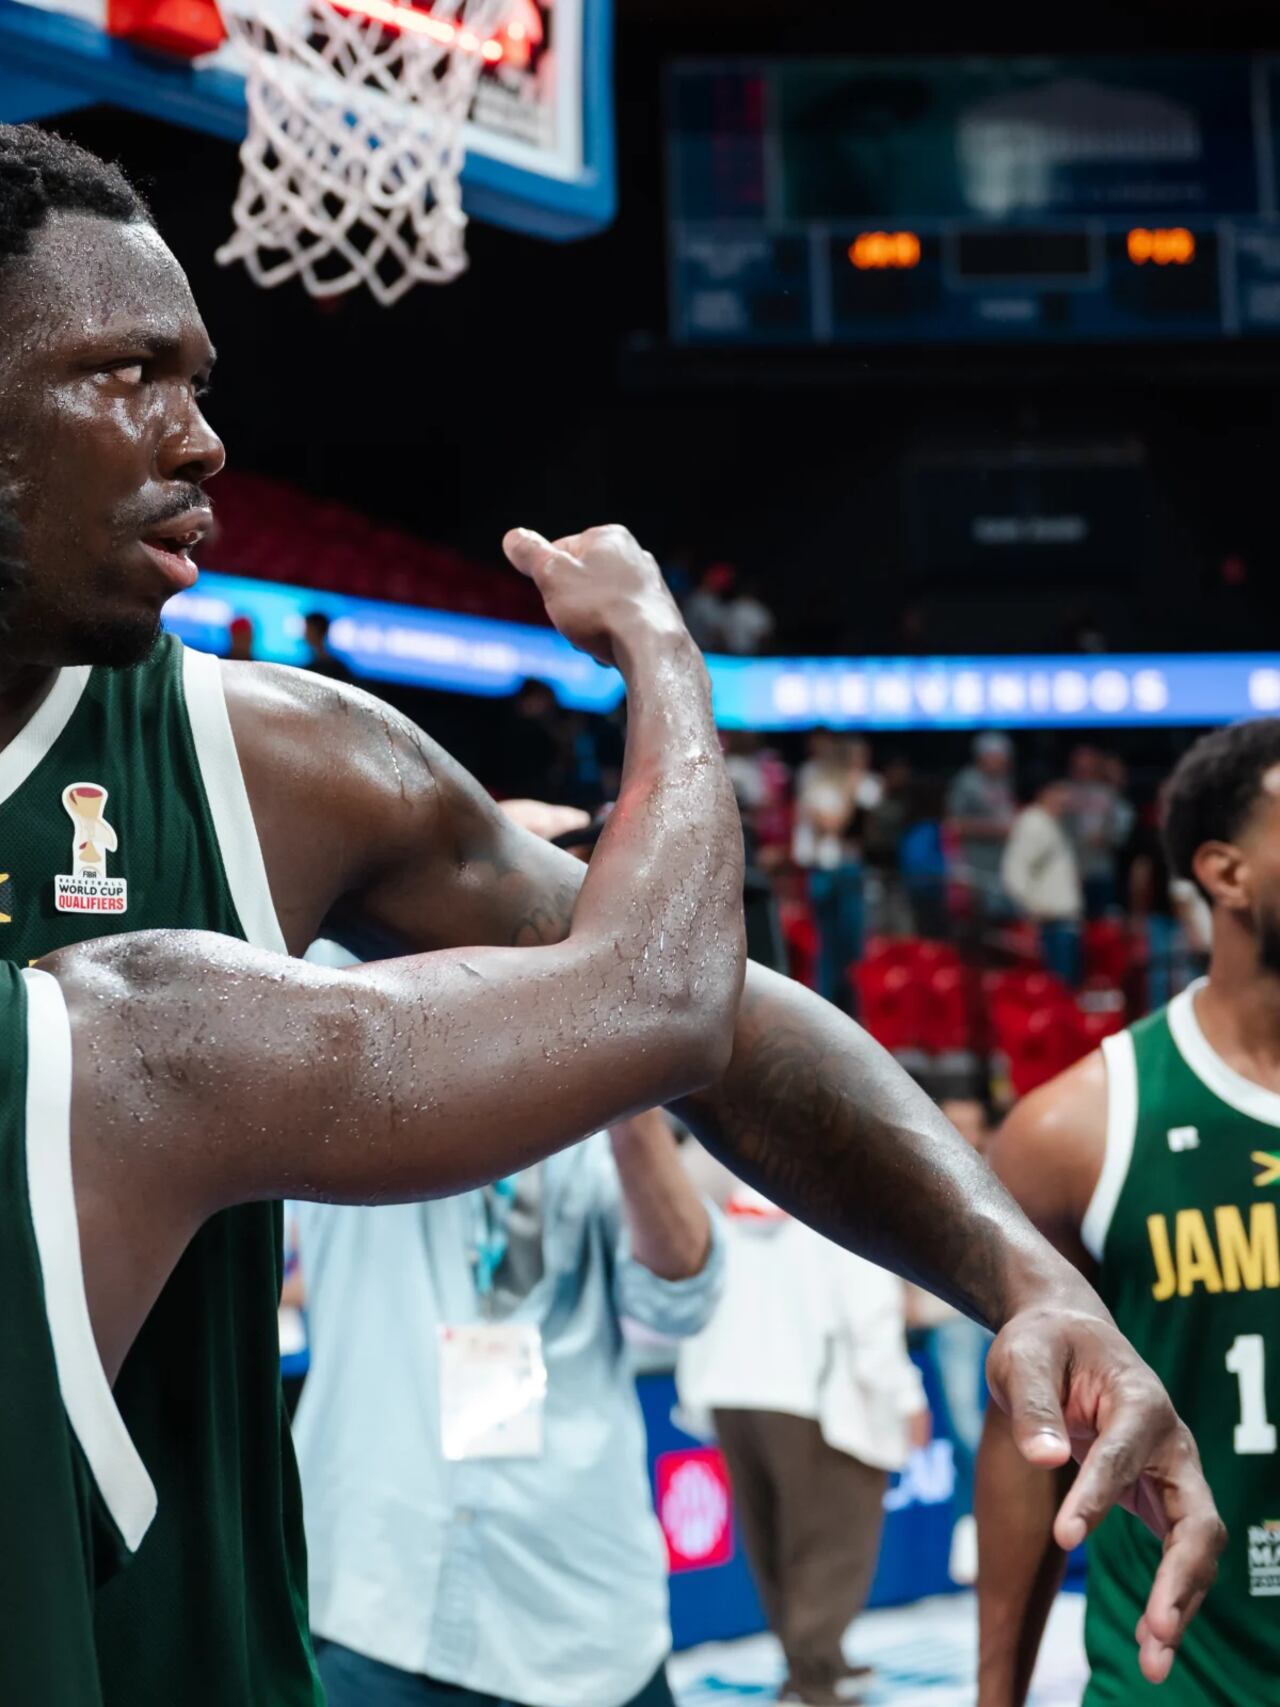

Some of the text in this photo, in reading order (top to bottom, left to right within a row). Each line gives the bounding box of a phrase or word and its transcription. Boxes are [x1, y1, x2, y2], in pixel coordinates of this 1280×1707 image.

[773, 669, 1168, 716] BIENVENIDOS
[59, 878, 122, 886] BASKETBALL
[82, 870, 97, 879] FIBA
[59, 884, 124, 896] WORLD CUP
[58, 895, 124, 910] QUALIFIERS
[1146, 1202, 1280, 1300] JAM
[1225, 1333, 1277, 1454] 1
